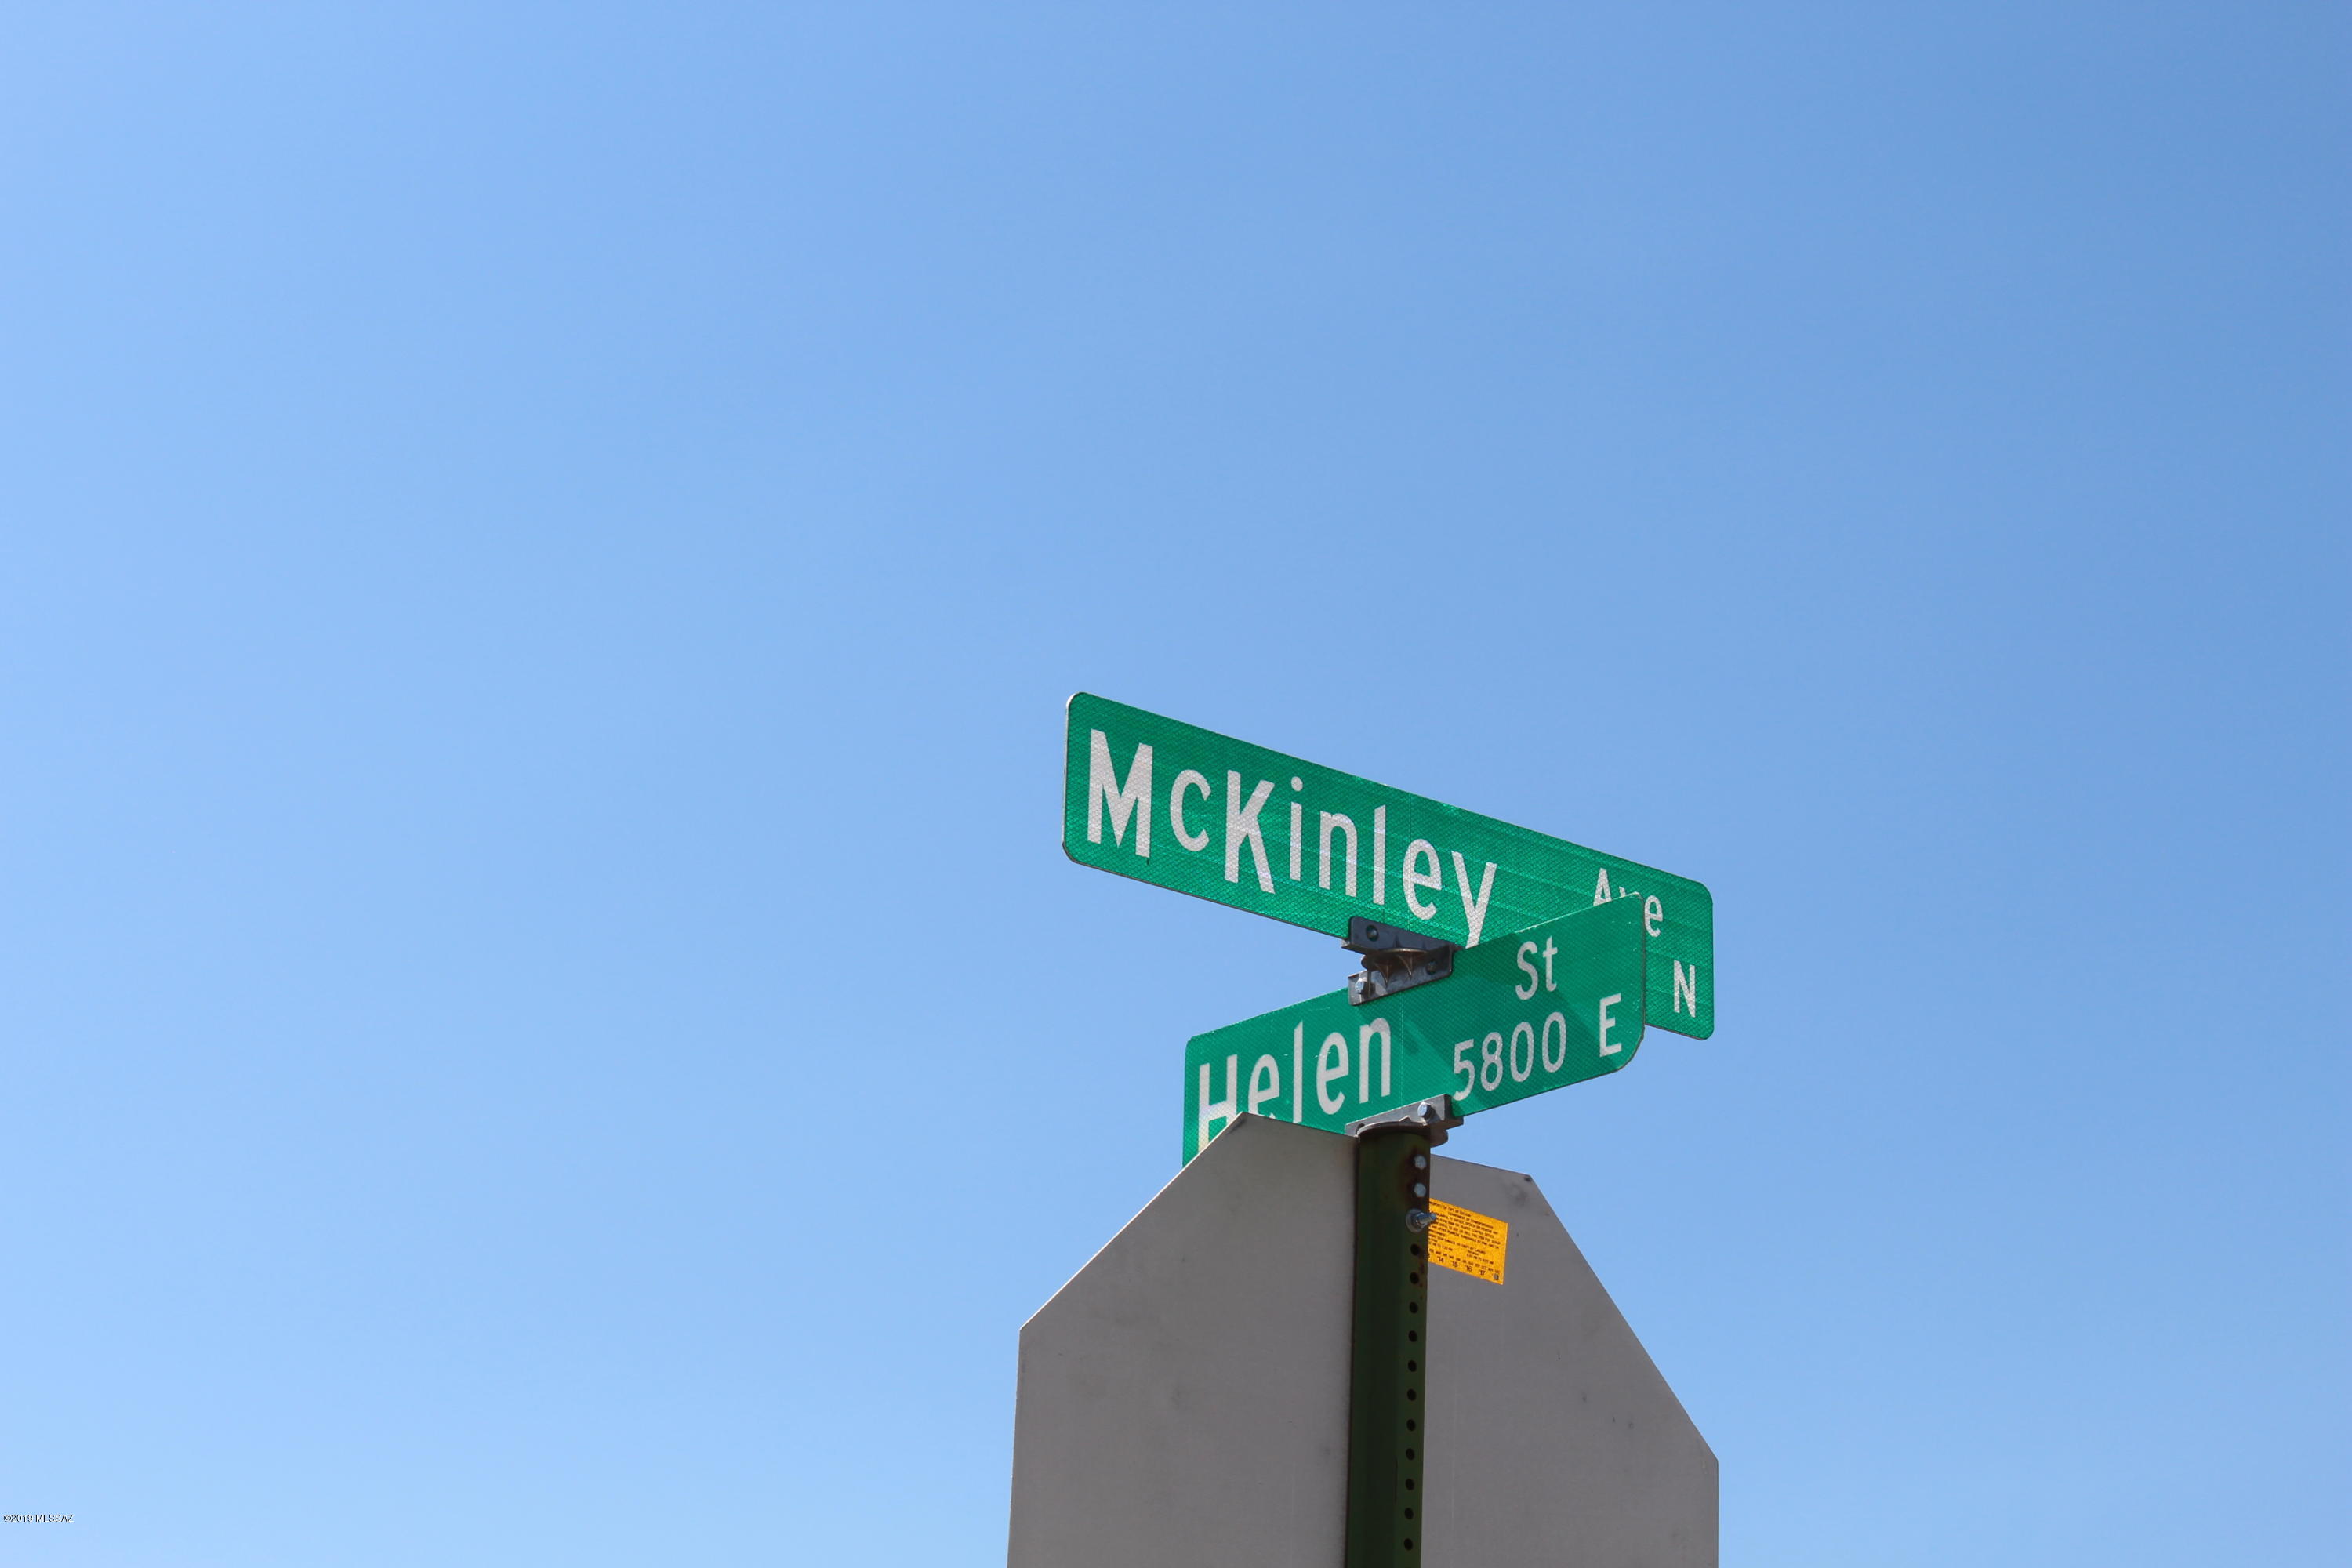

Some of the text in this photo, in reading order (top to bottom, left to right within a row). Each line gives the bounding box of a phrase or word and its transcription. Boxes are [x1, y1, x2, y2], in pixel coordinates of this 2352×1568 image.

[1087, 728, 1663, 948] McKinley Ae
[1198, 941, 1558, 1154] Helen St
[1453, 993, 1622, 1102] 5800 E
[1674, 960, 1697, 1018] N
